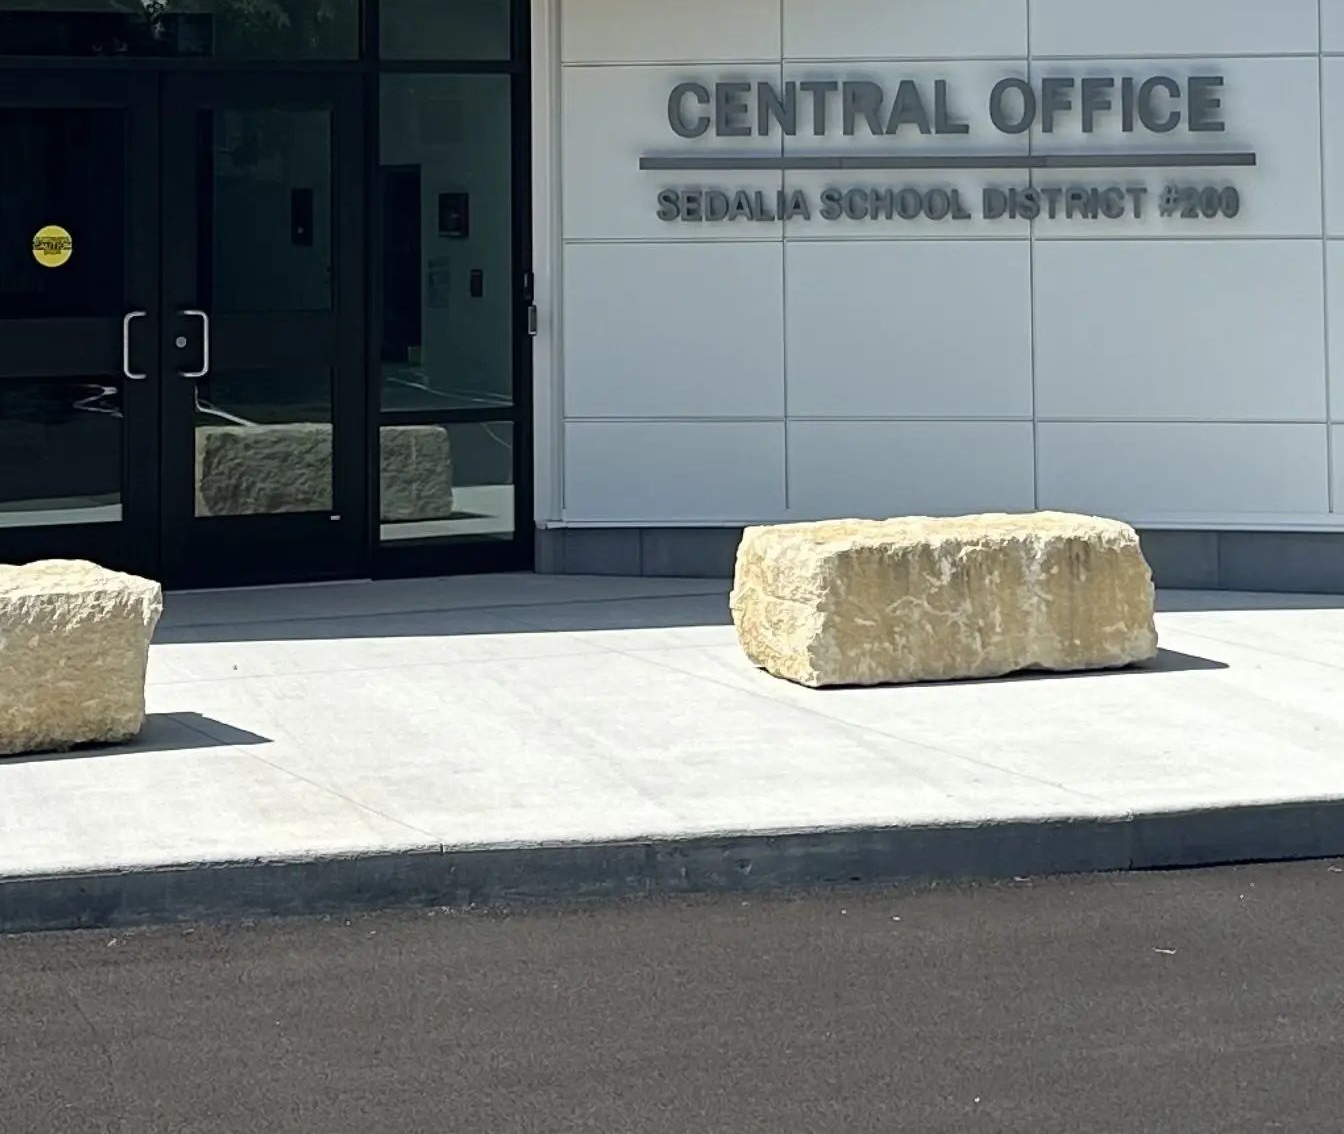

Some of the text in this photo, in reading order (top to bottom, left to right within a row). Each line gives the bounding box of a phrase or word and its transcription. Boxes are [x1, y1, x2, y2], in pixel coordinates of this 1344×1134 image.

[667, 75, 1226, 138] CENTRAL OFFICE
[656, 184, 1240, 222] SEDALIA SCHOOL DISTRICT #200
